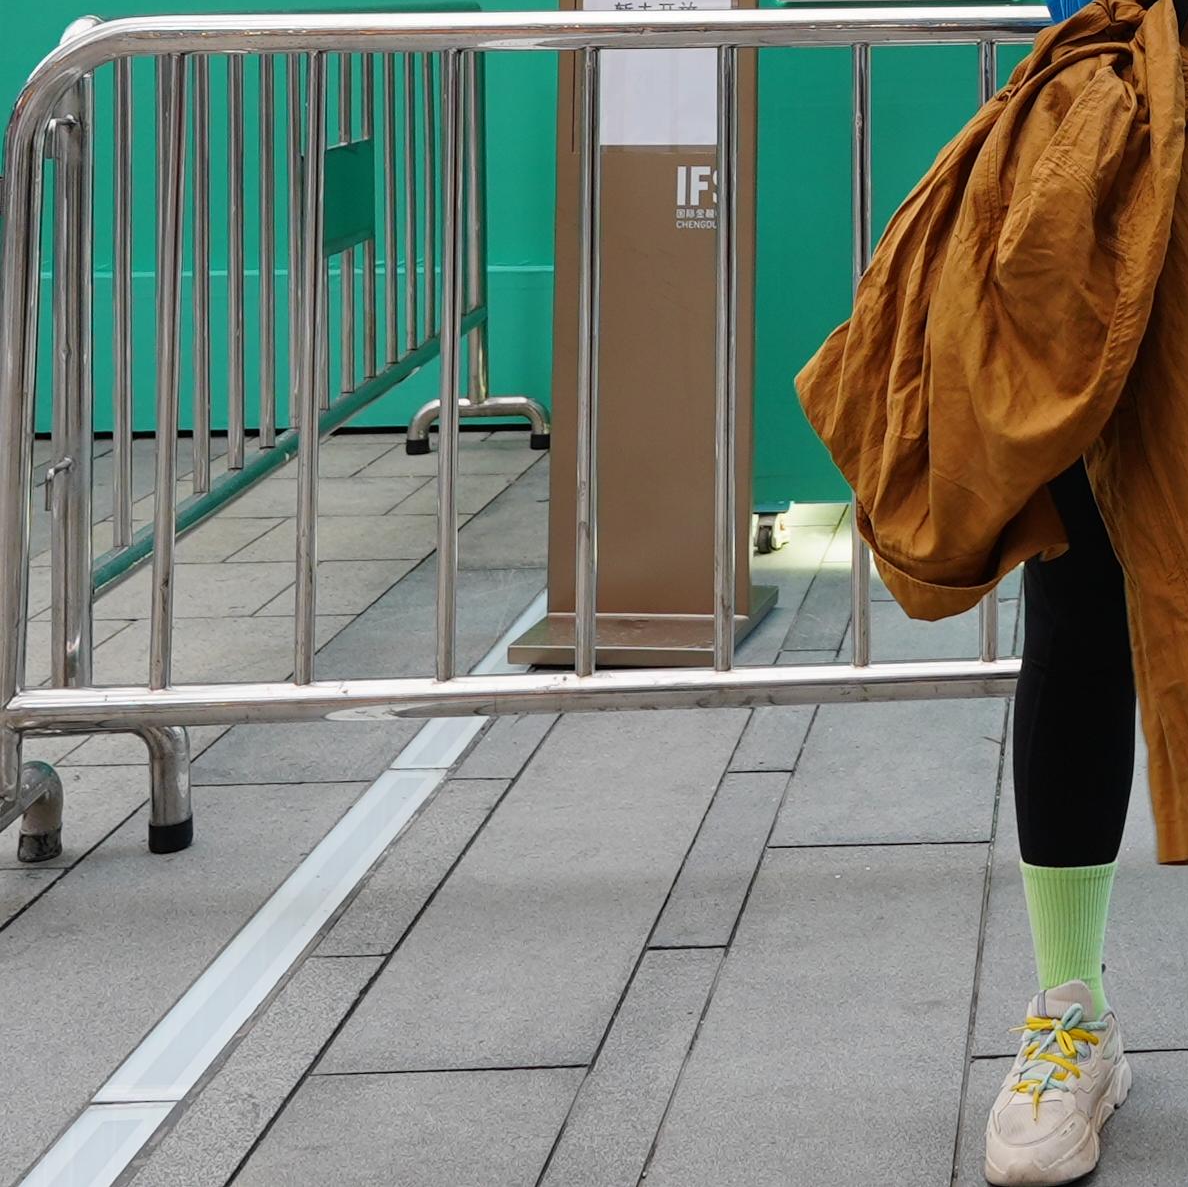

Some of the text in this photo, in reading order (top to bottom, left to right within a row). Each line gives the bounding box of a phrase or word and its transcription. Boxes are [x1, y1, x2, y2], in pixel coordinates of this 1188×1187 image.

[677, 165, 718, 206] IF
[676, 208, 718, 219] 国际金融
